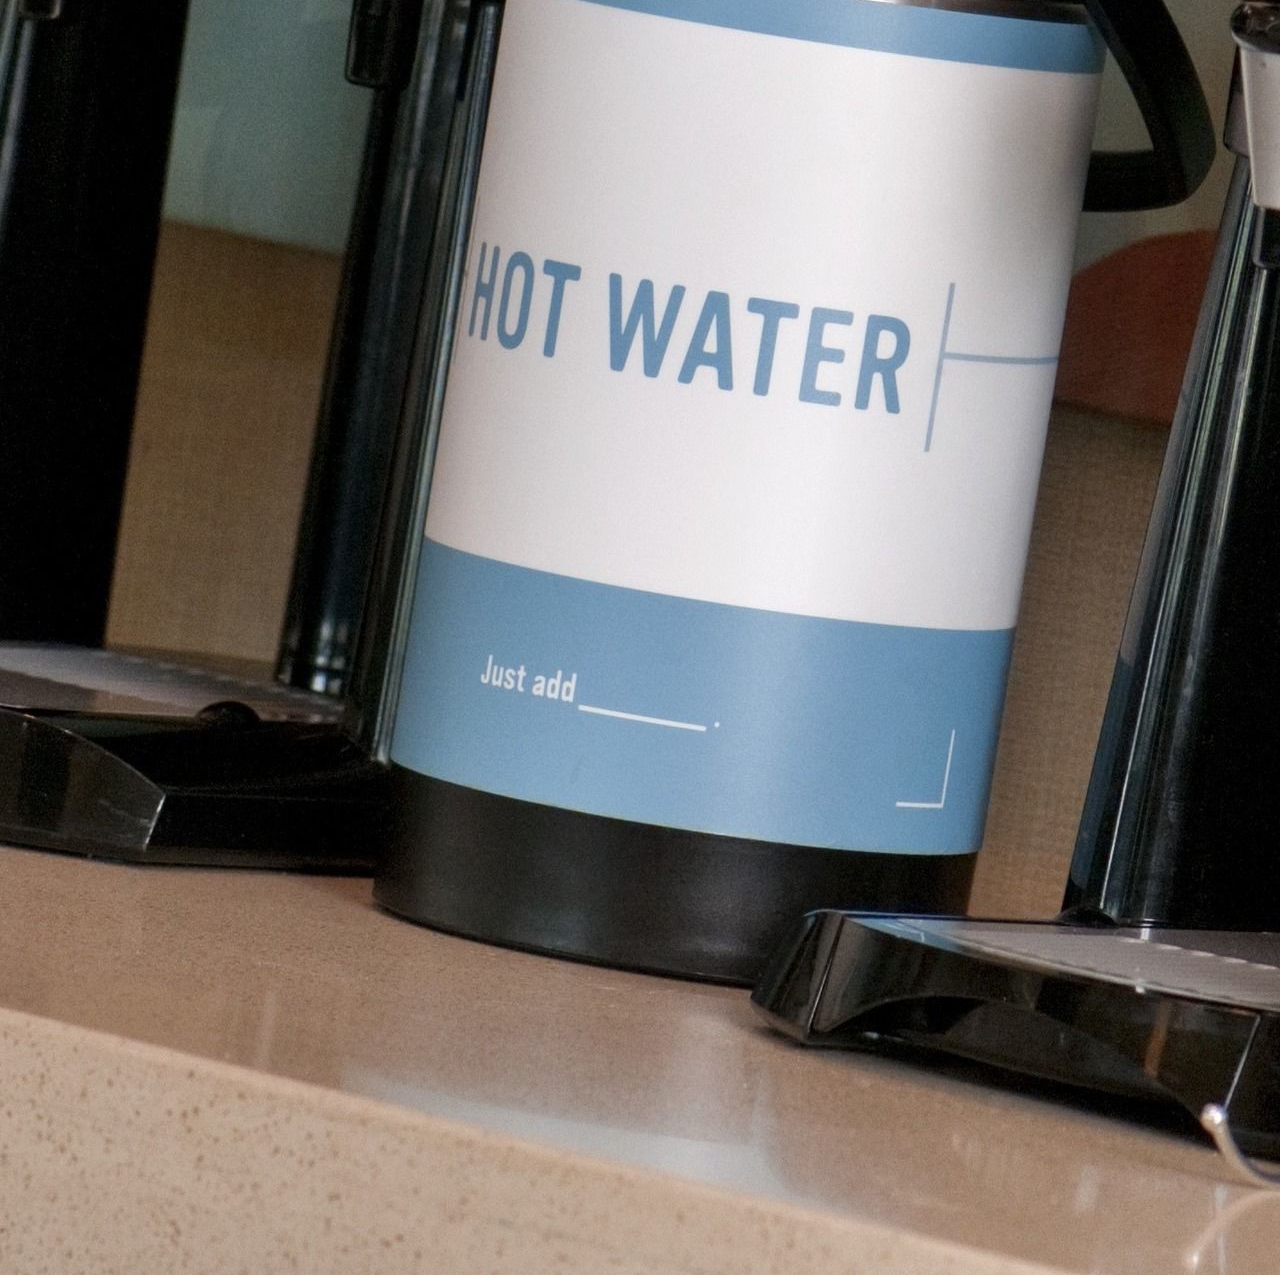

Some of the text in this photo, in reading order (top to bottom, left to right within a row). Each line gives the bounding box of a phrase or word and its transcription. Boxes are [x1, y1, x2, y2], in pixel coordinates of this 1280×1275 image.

[468, 241, 912, 414] HOT WATER
[480, 654, 577, 703] Just add
